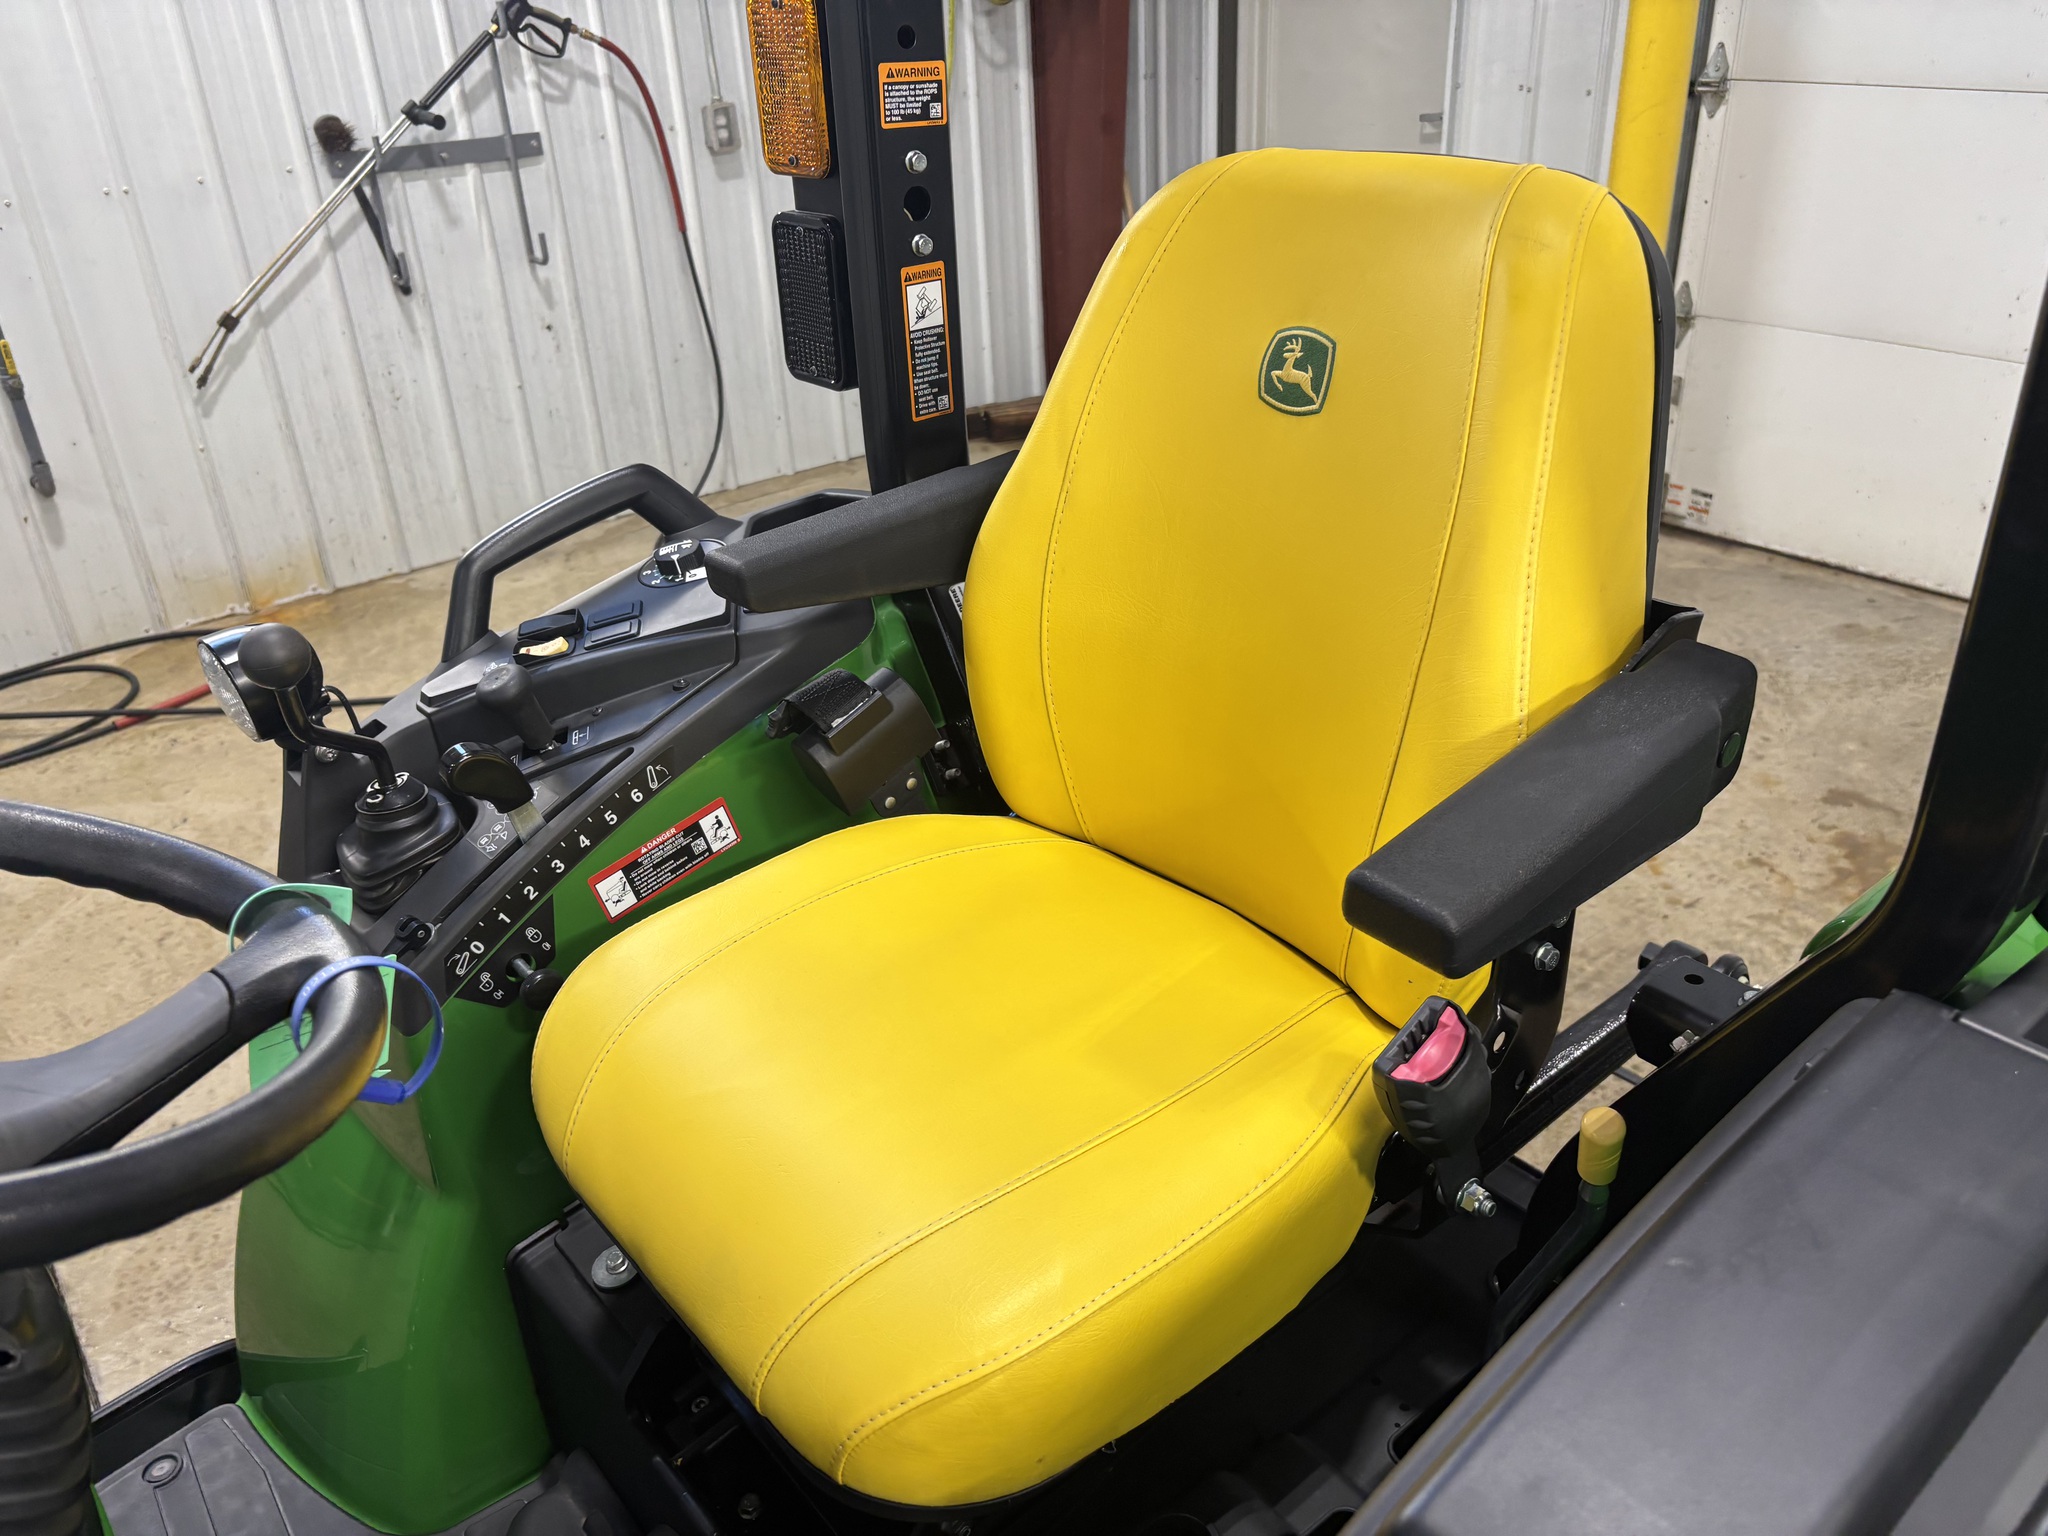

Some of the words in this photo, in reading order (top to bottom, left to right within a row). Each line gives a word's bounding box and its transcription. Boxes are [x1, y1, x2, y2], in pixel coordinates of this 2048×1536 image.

[895, 67, 940, 78] WARNING
[912, 268, 942, 281] WARNING
[647, 827, 677, 849] DANGER
[651, 850, 663, 859] ARMS
[673, 837, 684, 846] LEGS
[638, 848, 659, 862] ROTATING
[659, 837, 675, 849] BLADES
[470, 941, 485, 954] 0
[498, 912, 511, 924] 1
[523, 885, 539, 900] 2
[552, 859, 565, 873] 3
[579, 835, 591, 849] 4
[604, 810, 618, 825] 5
[631, 788, 644, 802] 6
